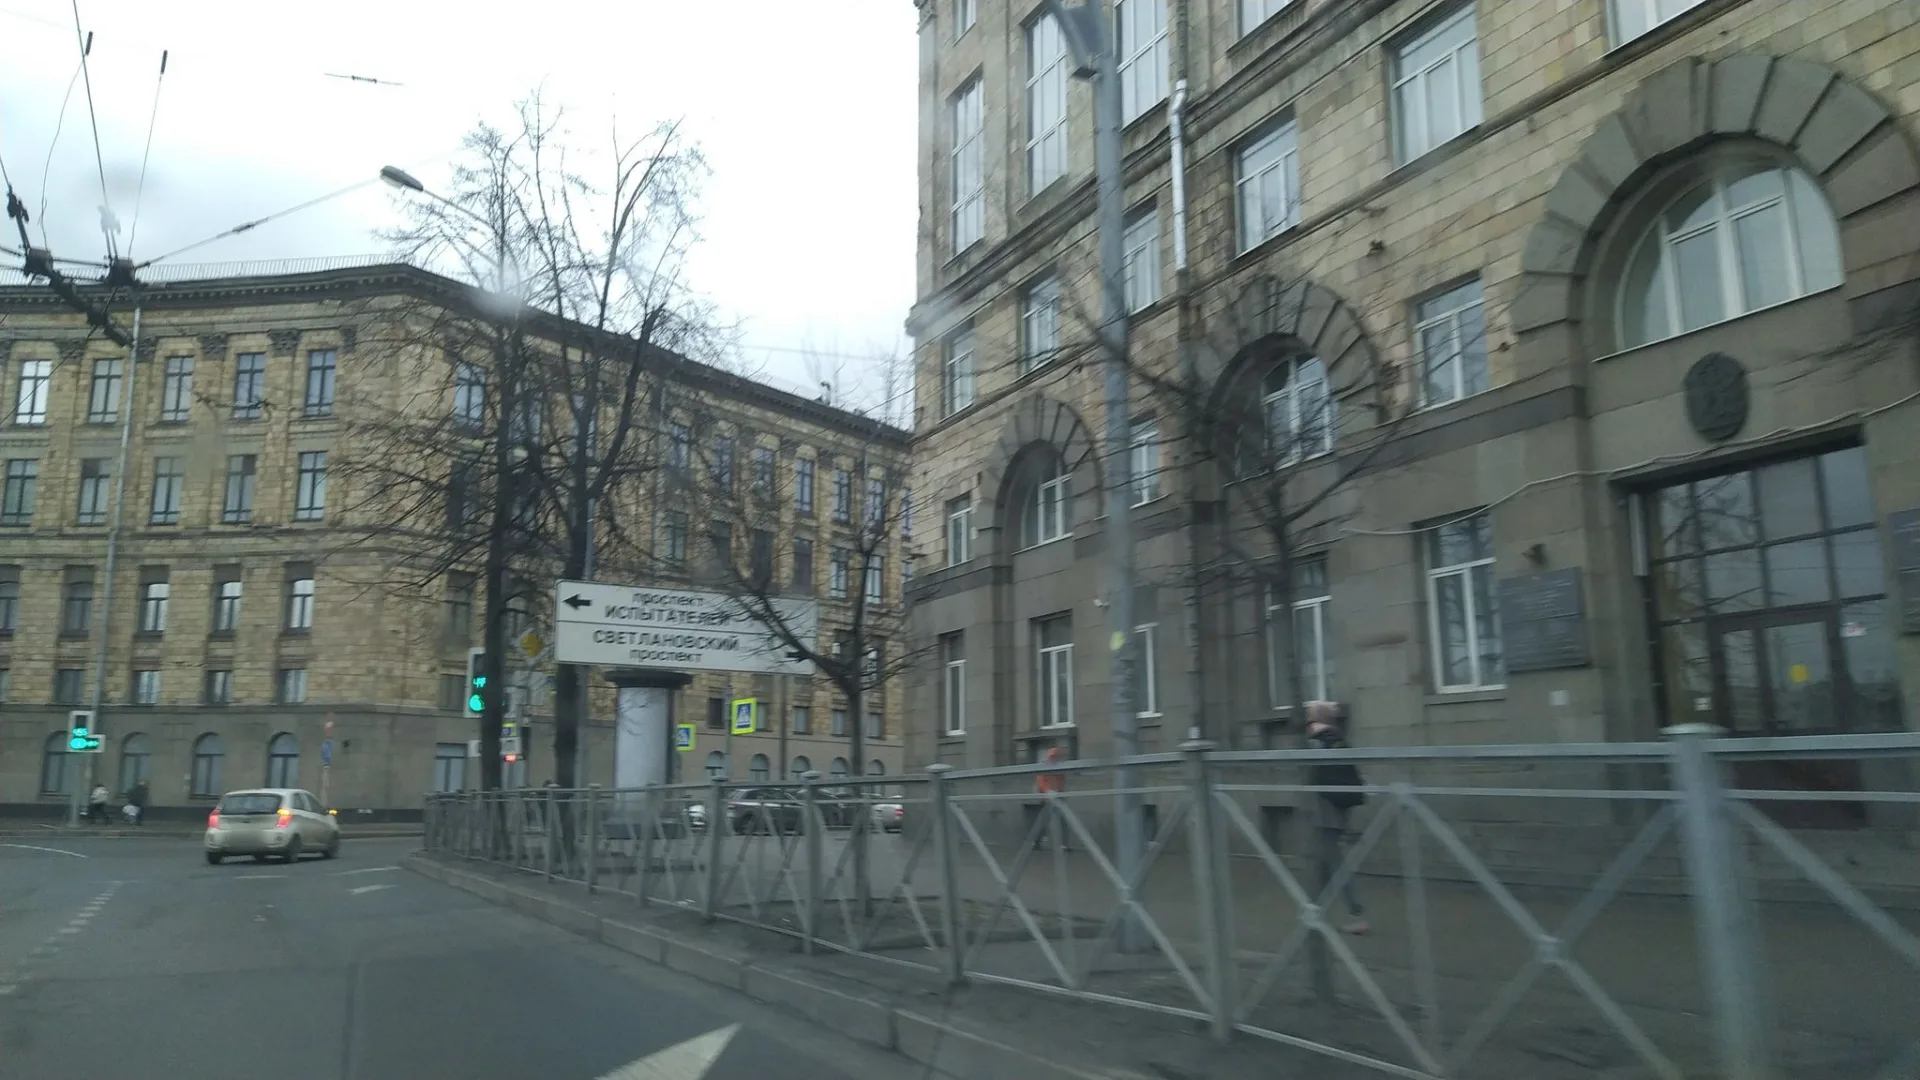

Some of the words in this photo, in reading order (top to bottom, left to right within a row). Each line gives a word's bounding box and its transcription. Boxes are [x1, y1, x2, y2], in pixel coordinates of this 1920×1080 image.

[632, 592, 704, 608] проспект
[593, 630, 740, 651] СВЕТЛАНОВСКИЙ
[630, 649, 702, 663] проспект
